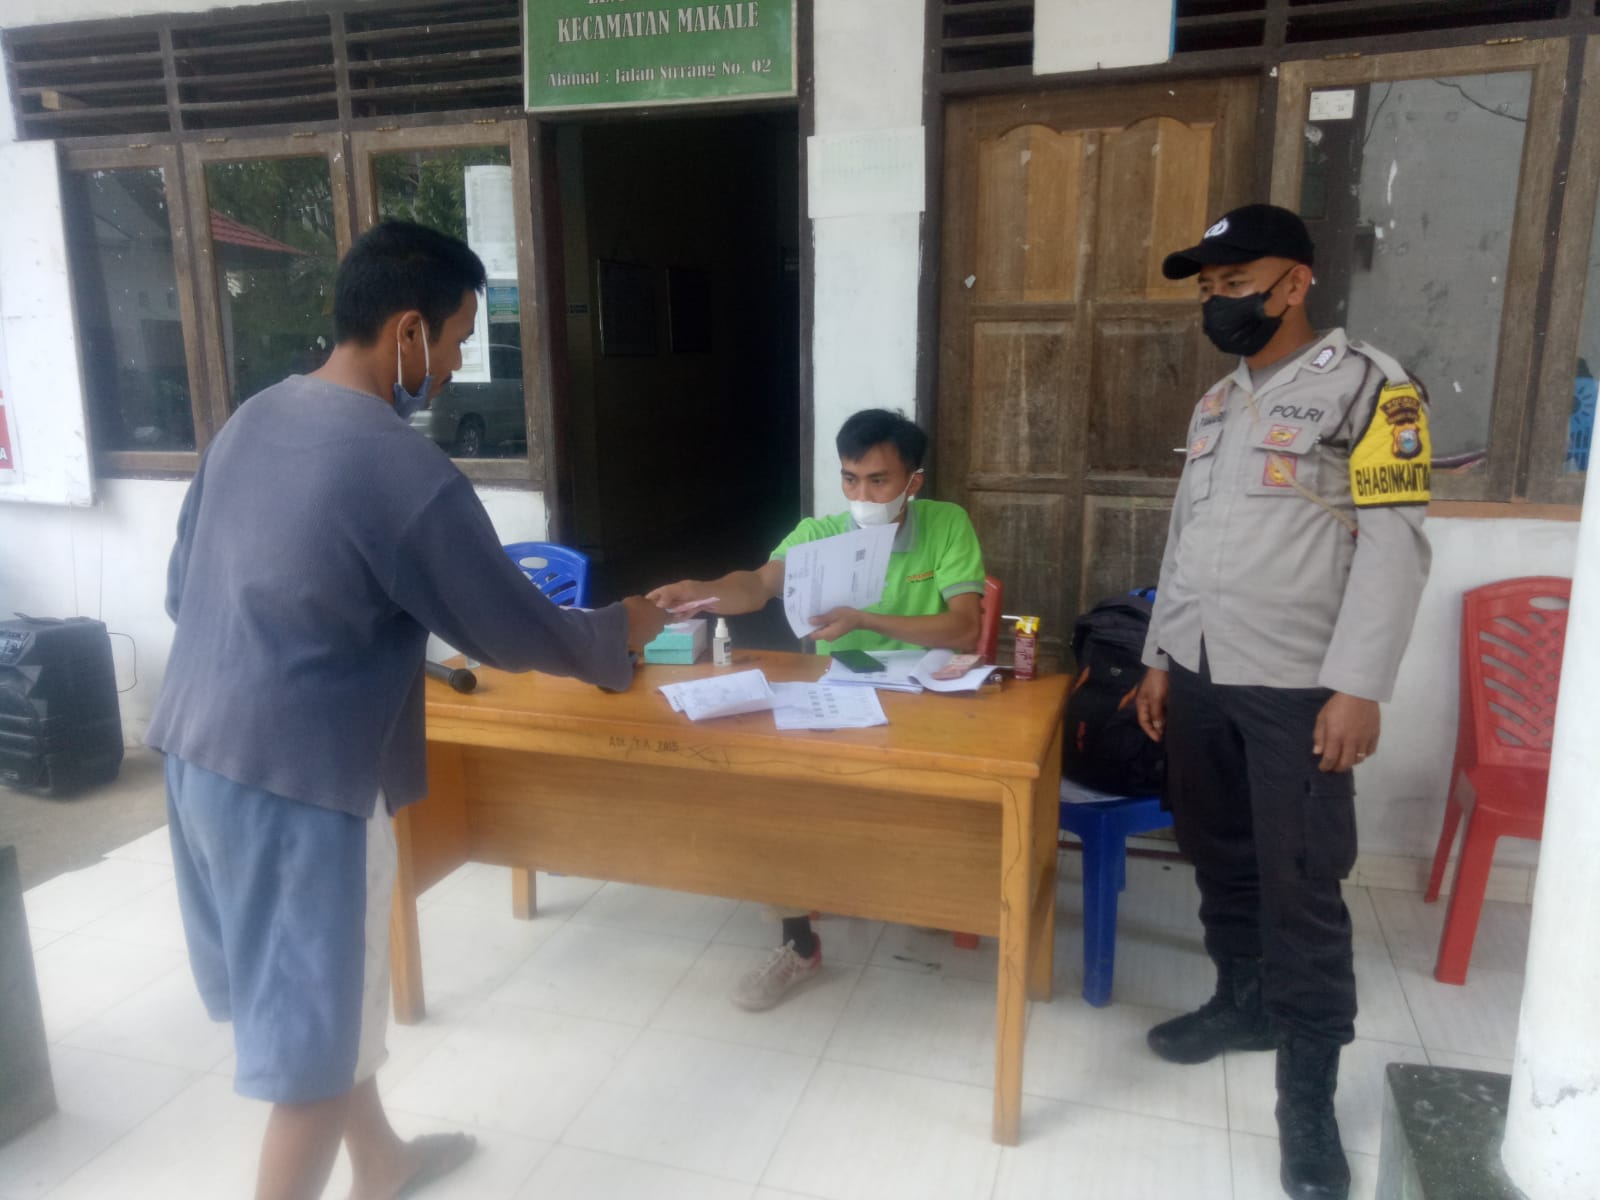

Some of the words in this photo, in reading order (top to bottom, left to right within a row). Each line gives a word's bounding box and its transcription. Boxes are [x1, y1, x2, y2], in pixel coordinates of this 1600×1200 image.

[557, 9, 670, 43] KECAMATAN
[677, 1, 759, 33] MAKALE
[547, 71, 600, 87] Alamat
[615, 67, 655, 84] Jalan
[722, 60, 745, 76] No.
[751, 58, 772, 73] 02
[1269, 405, 1325, 423] POLRI
